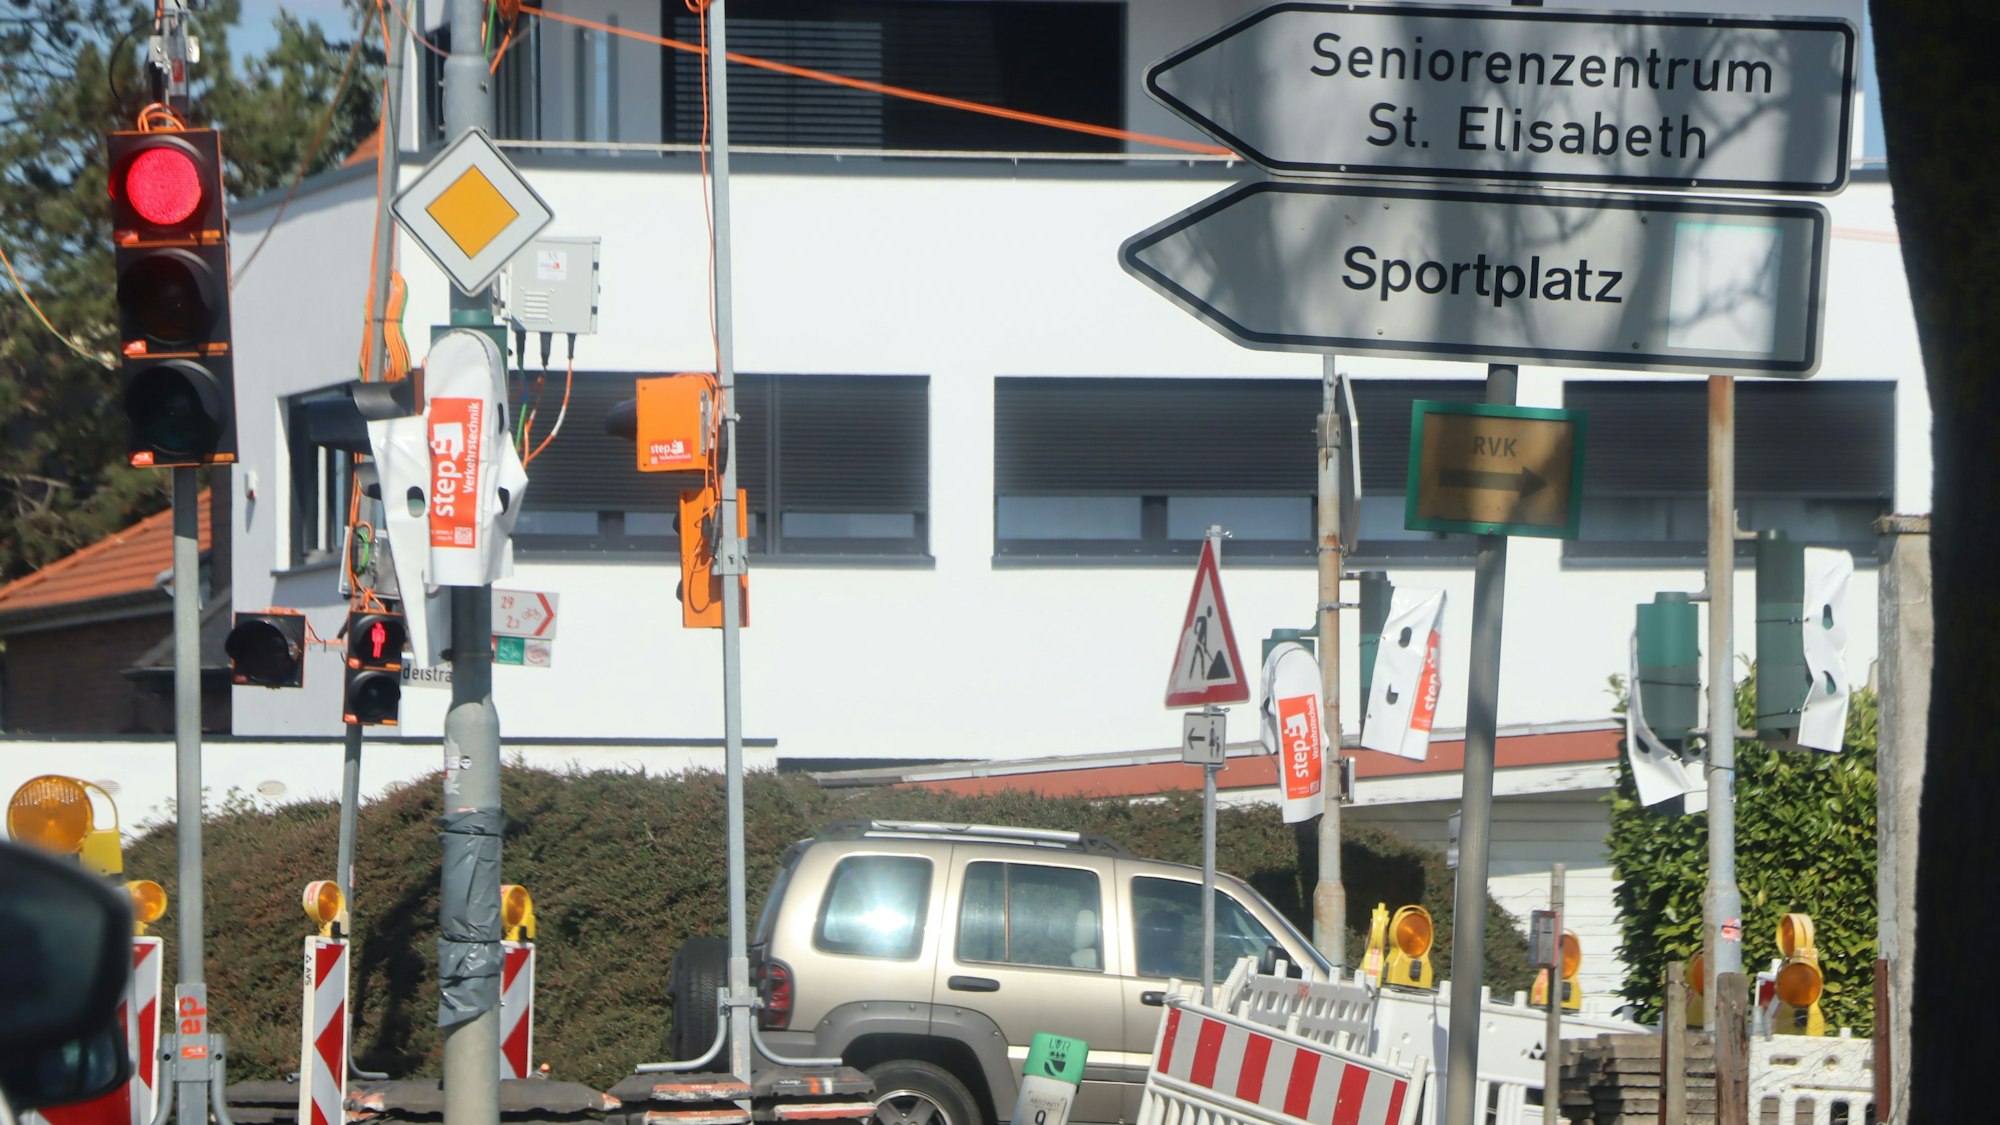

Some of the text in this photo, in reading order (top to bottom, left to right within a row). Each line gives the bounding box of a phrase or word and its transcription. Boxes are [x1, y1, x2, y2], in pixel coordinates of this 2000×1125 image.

[1309, 32, 1772, 94] Seniorenzentrum
[1365, 102, 1706, 161] St. Elisabeth
[1341, 245, 1623, 308] Sportplatz
[462, 402, 480, 494] Verkehrstechnik
[650, 444, 671, 457] step
[1473, 436, 1518, 458] RVK
[432, 460, 463, 517] step
[501, 596, 514, 609] 29
[402, 664, 453, 683] delstra
[1306, 696, 1319, 760] Verkehrstechnik
[1293, 739, 1311, 778] step
[1049, 1038, 1071, 1052] LVR
